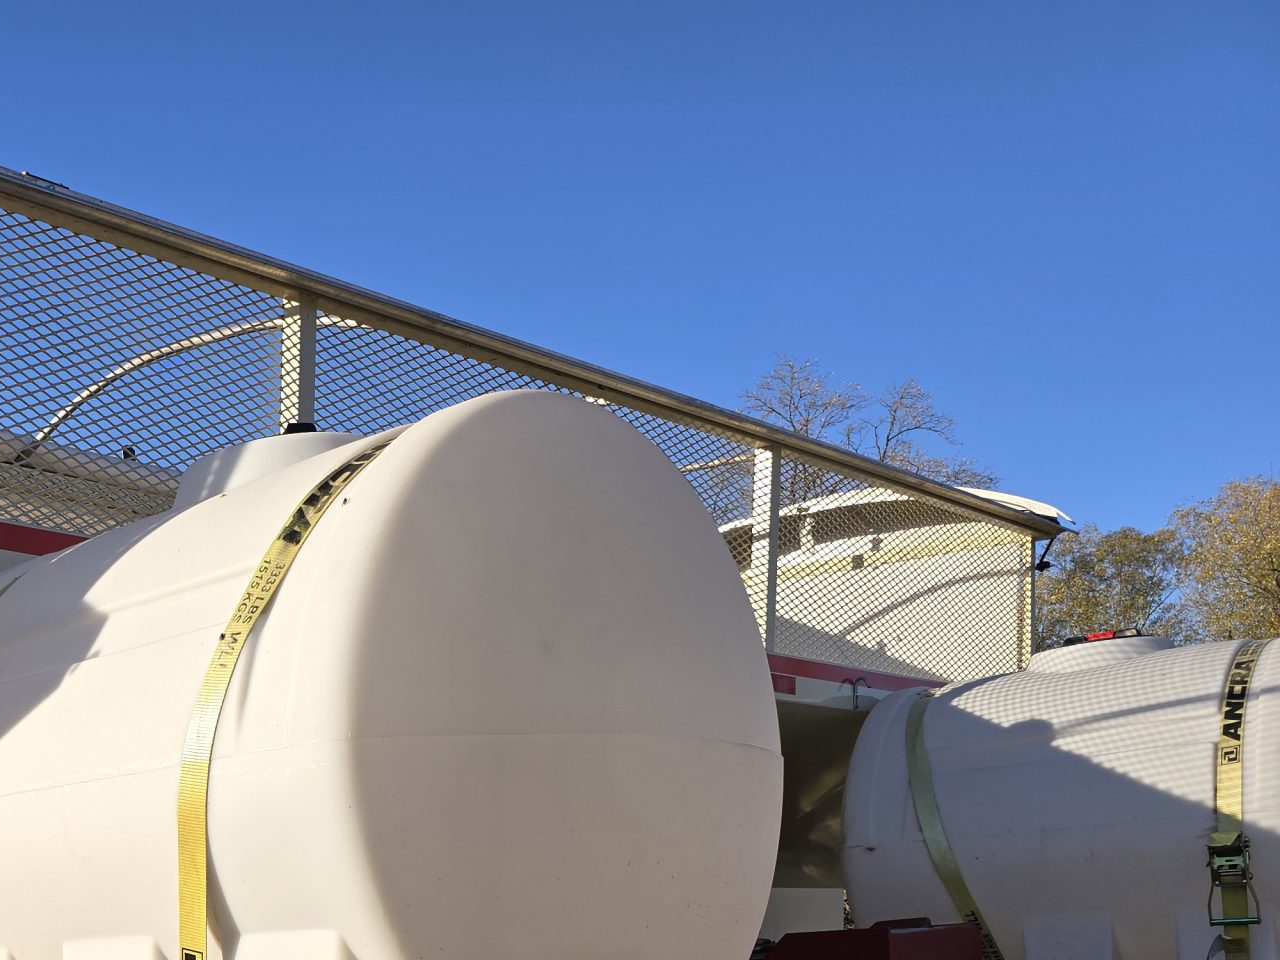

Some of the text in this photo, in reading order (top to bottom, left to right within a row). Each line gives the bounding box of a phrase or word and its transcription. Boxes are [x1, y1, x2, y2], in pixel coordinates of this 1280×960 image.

[242, 562, 285, 624] 3333 LBS
[1222, 659, 1255, 742] ANCRA
